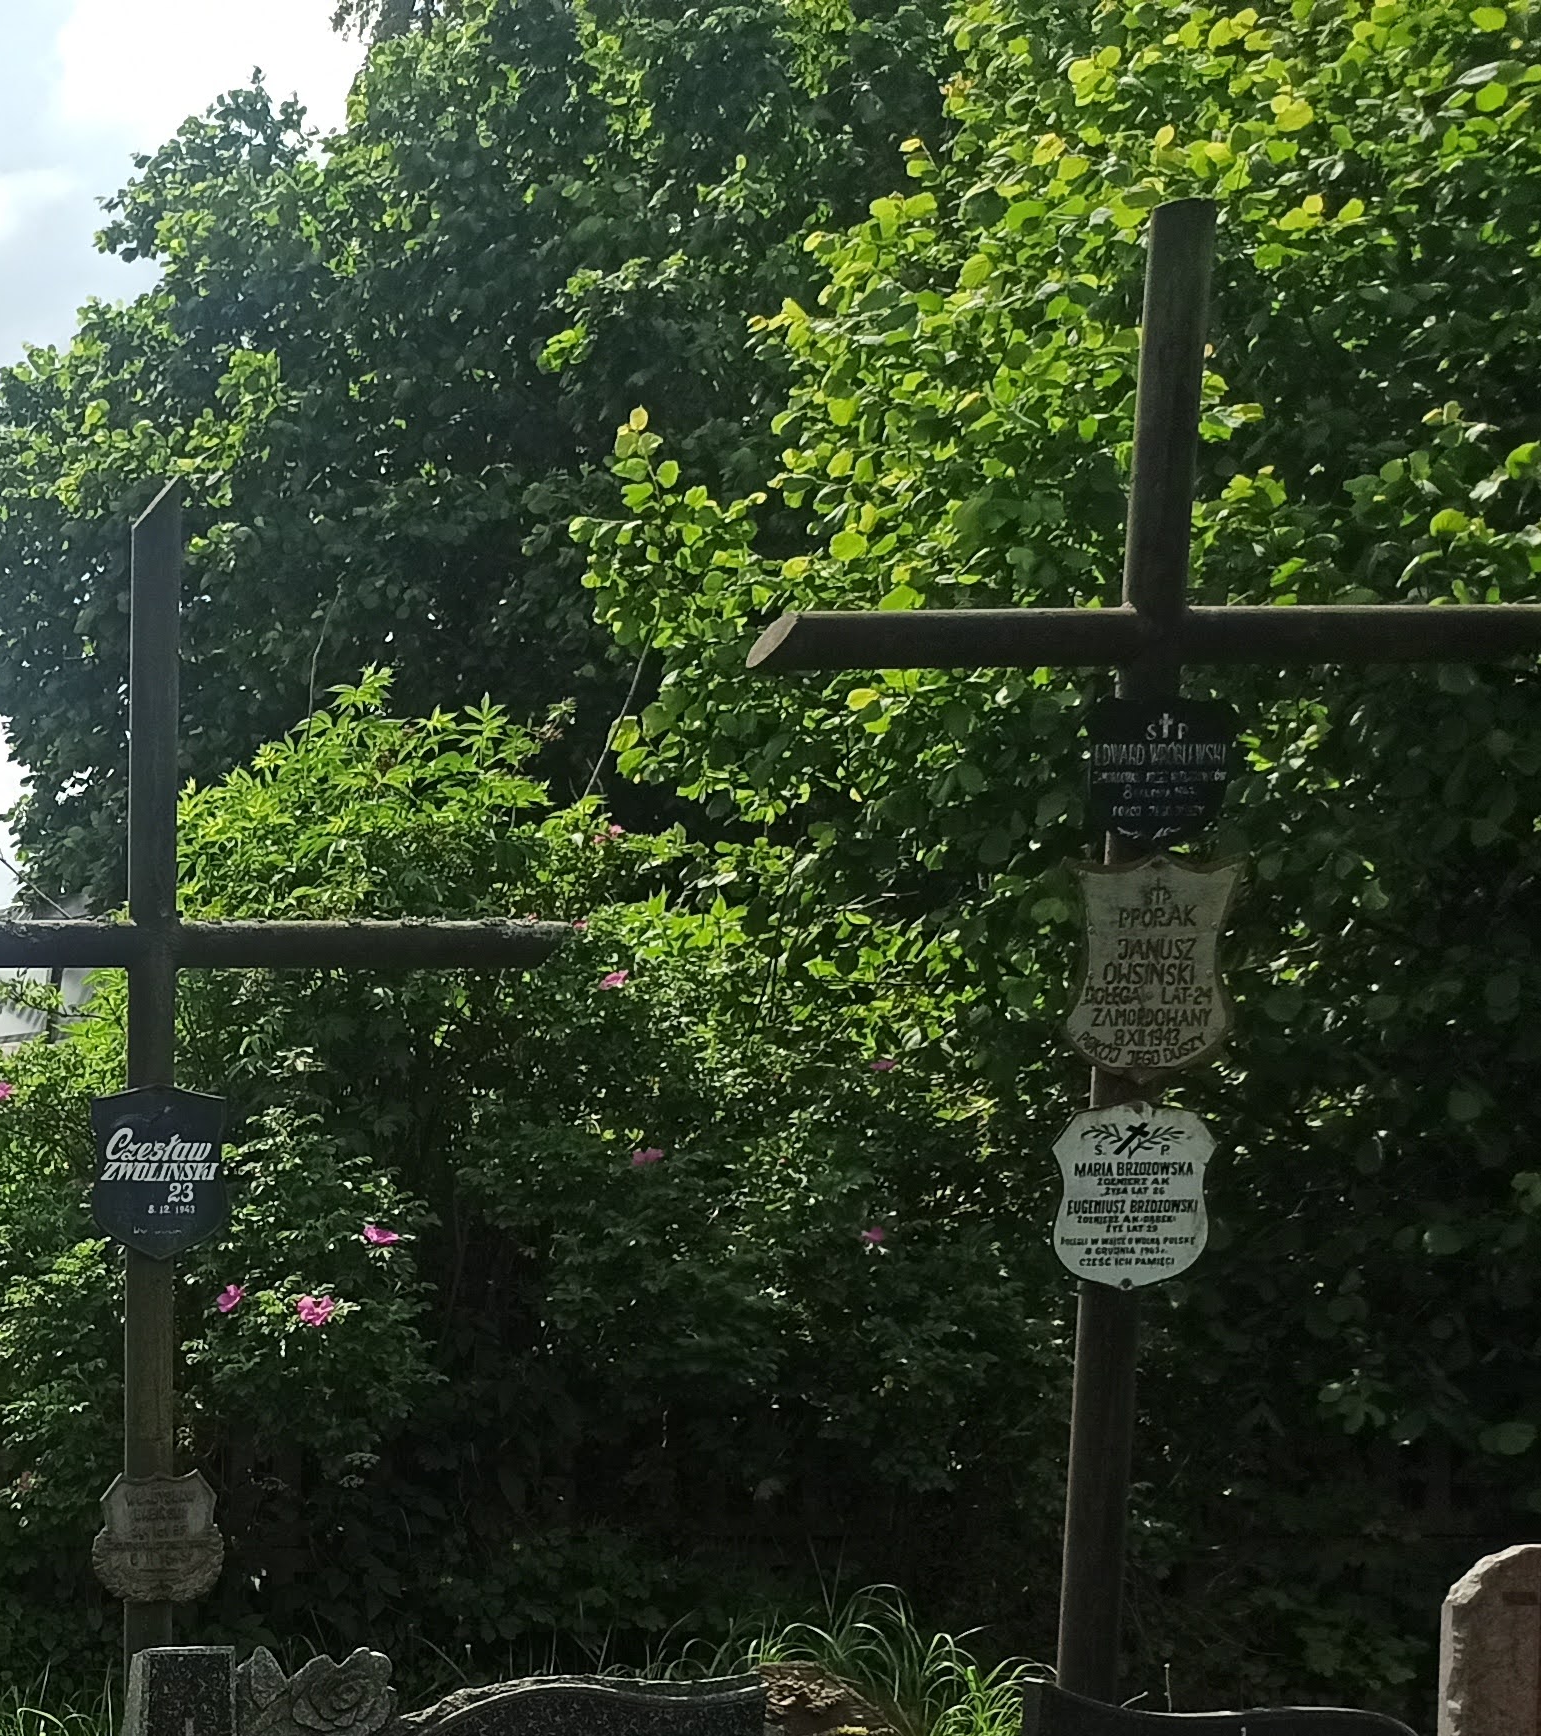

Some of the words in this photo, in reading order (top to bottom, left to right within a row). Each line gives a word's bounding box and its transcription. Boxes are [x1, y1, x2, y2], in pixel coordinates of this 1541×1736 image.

[1117, 937, 1197, 961] JANUSZ
[1125, 1050, 1160, 1065] JEGO
[106, 1128, 212, 1161] Czesław
[1074, 1162, 1113, 1177] MARIA
[167, 1183, 194, 1203] 23
[175, 1205, 195, 1214] 1943
